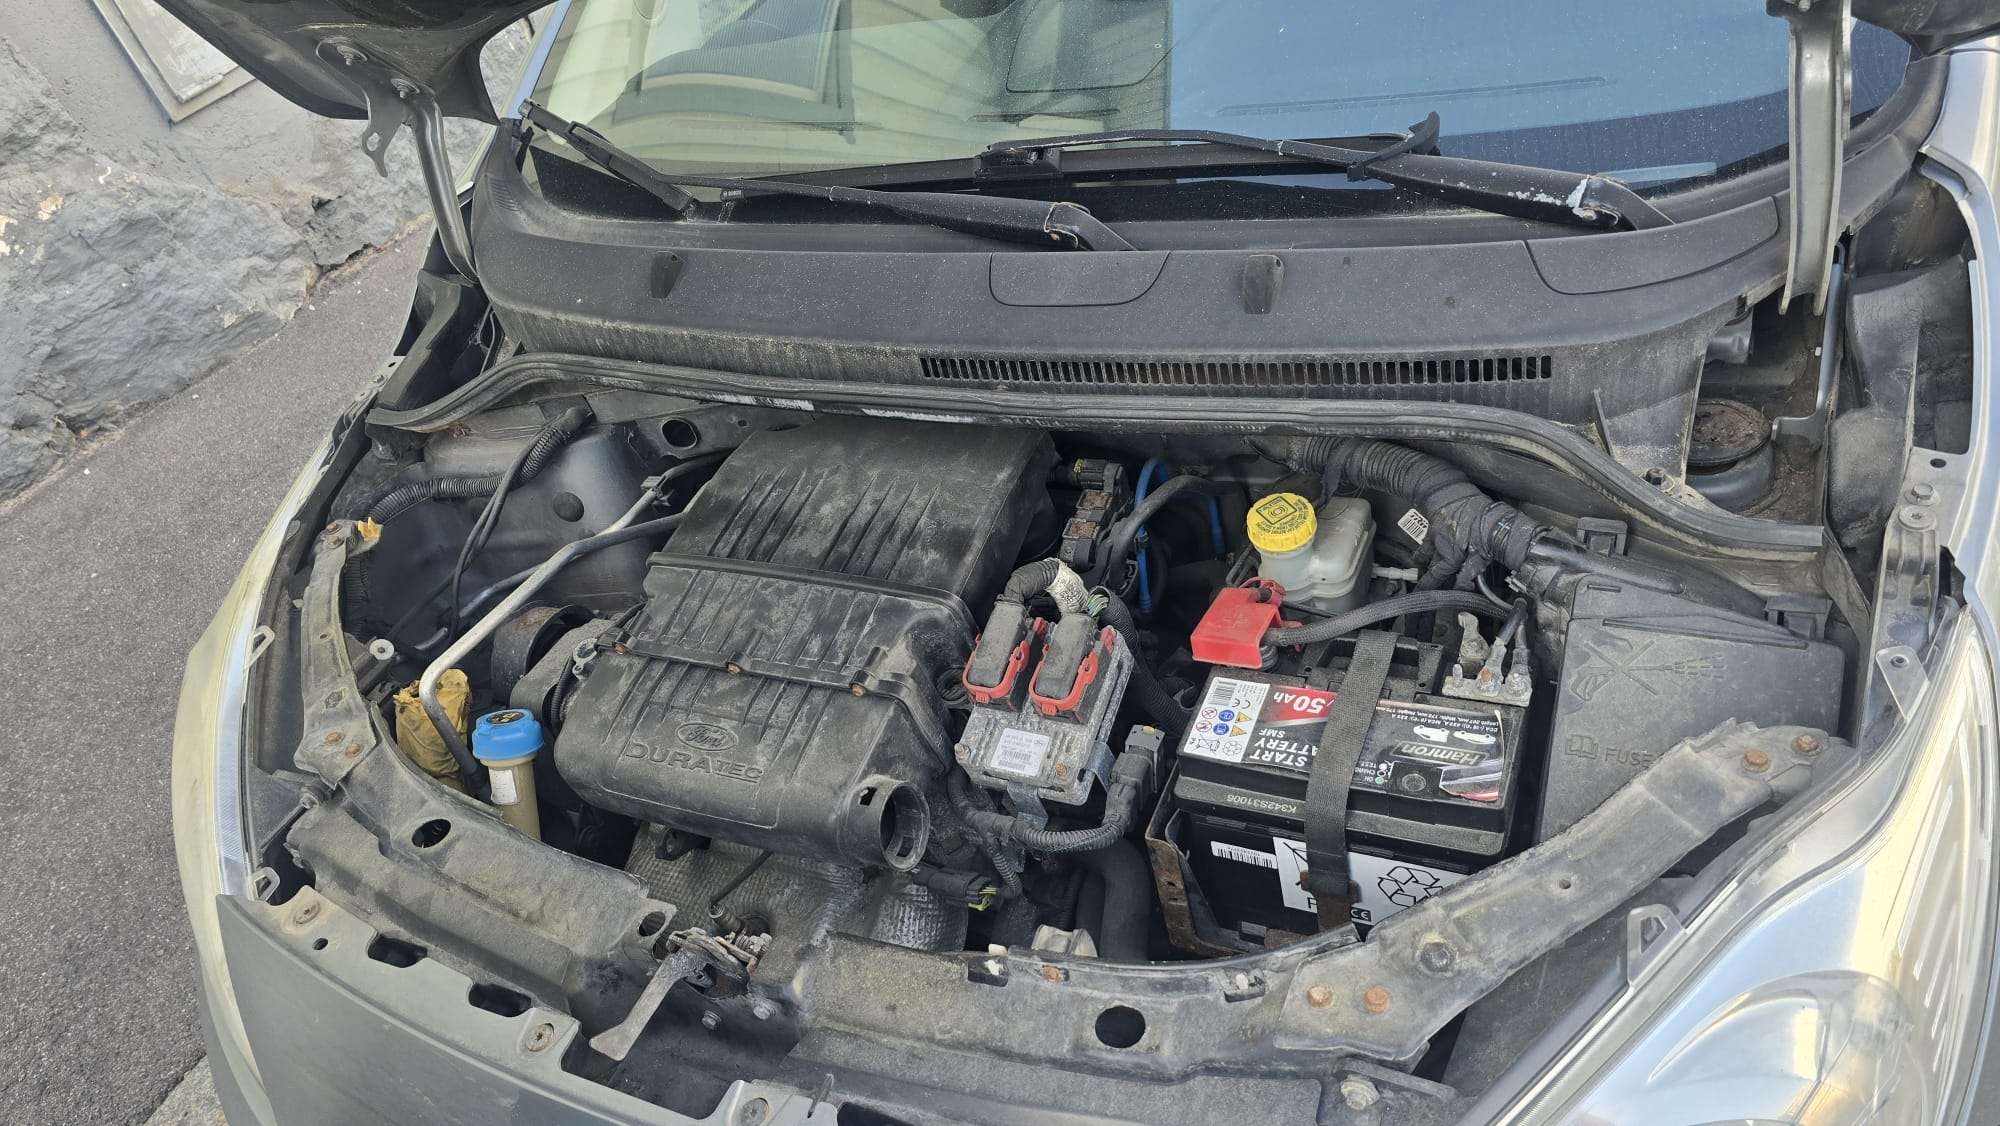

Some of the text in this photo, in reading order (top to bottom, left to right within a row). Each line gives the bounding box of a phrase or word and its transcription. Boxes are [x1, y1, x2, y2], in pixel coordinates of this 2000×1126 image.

[1259, 728, 1286, 738] SMF
[1254, 737, 1319, 757] ATTERY
[1401, 743, 1481, 766] Hamron
[625, 740, 763, 779] DURATEC
[1249, 749, 1308, 767] START
